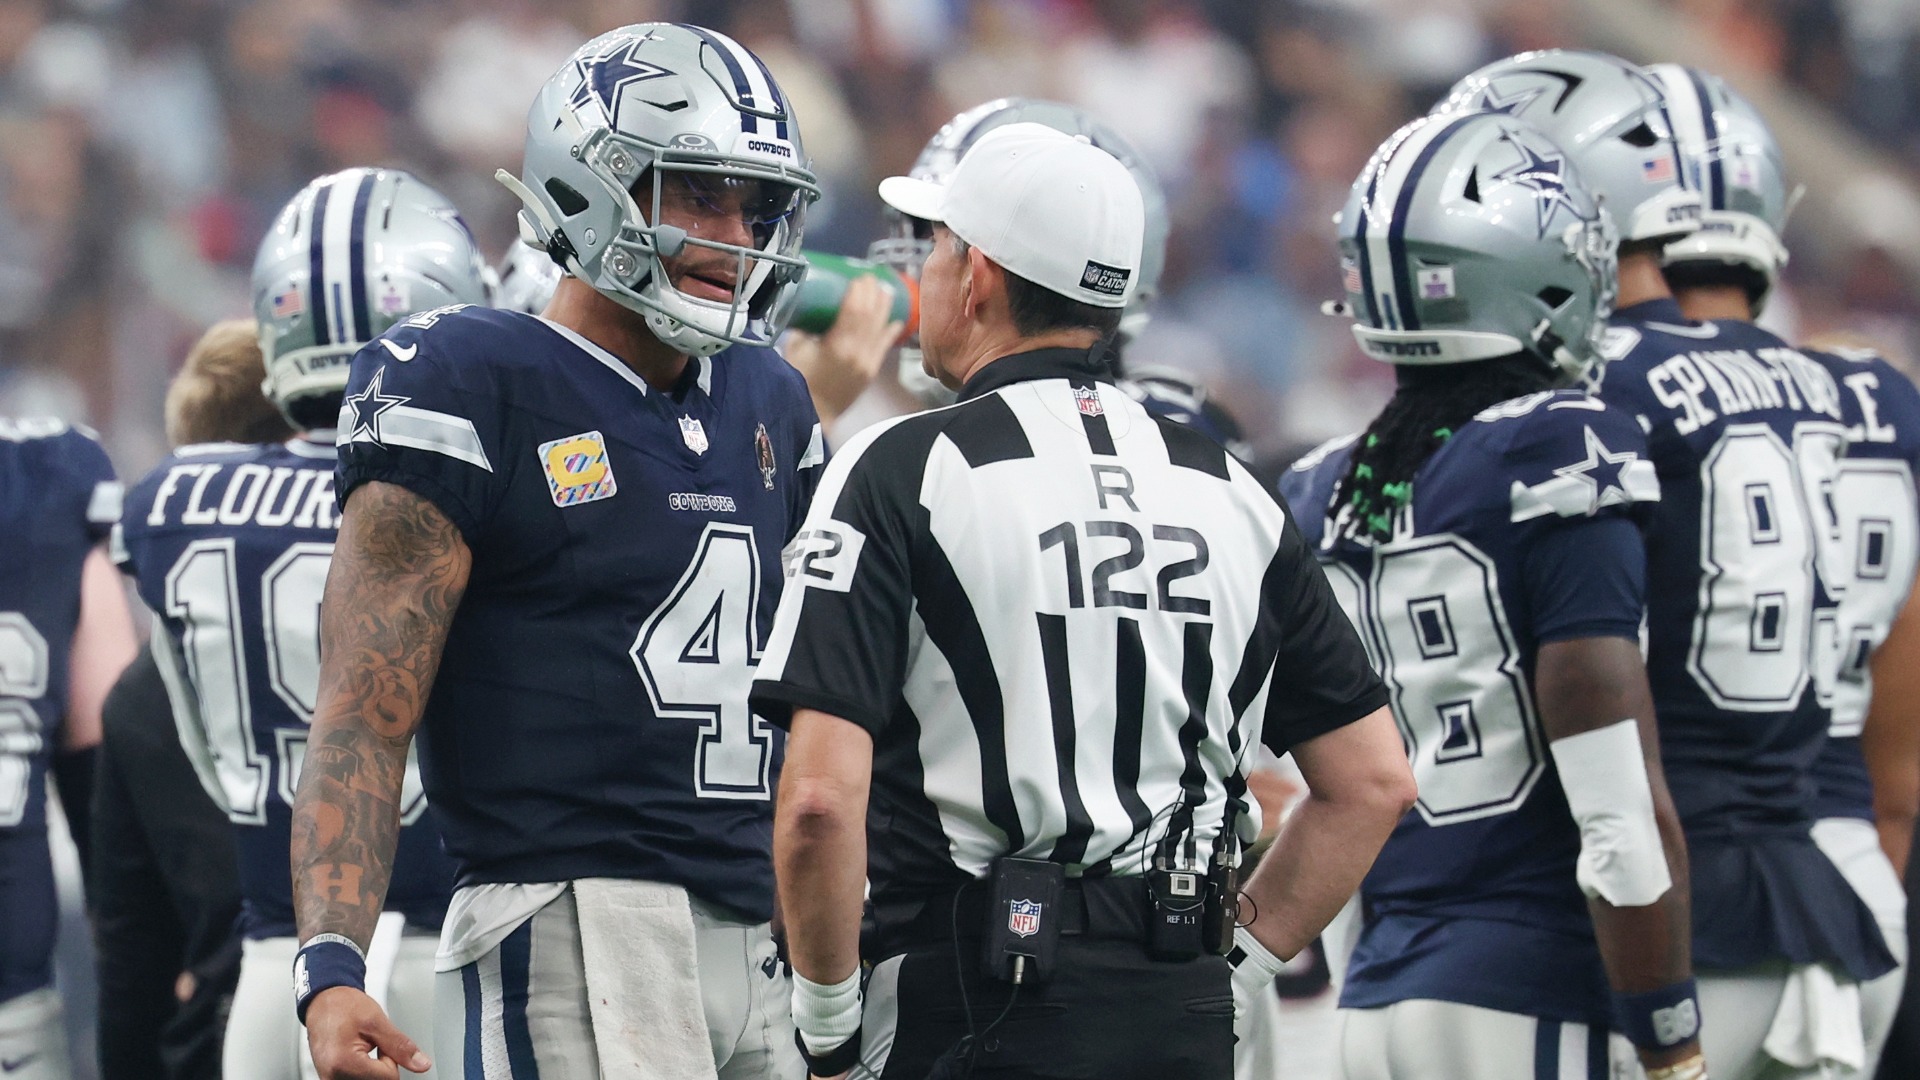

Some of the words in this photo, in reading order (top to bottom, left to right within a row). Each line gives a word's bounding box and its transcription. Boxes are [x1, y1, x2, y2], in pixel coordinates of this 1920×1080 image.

[748, 140, 791, 158] COWBOYS
[1097, 275, 1129, 289] CATCH
[548, 438, 605, 488] C
[147, 463, 343, 529] FLOUR
[1090, 464, 1141, 512] R
[669, 493, 737, 512] COWBOYS
[1038, 521, 1211, 616] 122
[628, 521, 773, 801] 4
[1012, 914, 1036, 932] NFL
[1166, 915, 1181, 924] REF
[1184, 915, 1195, 925] 1.1
[316, 934, 338, 943] FAITH
